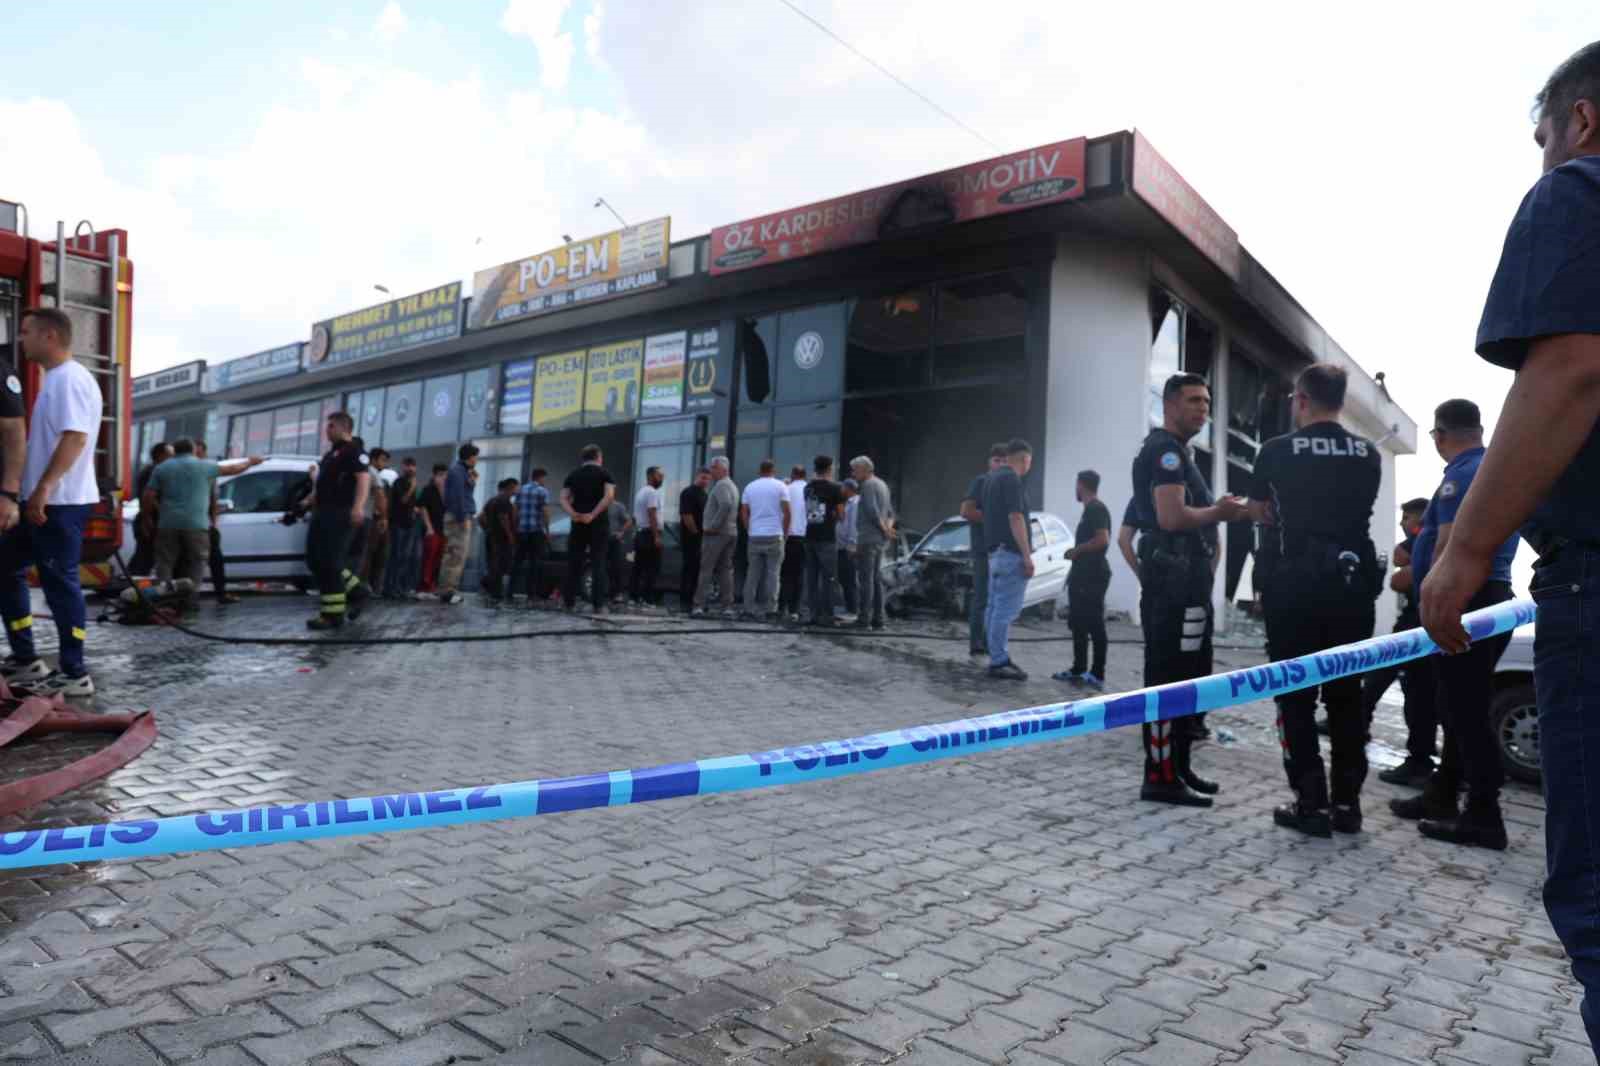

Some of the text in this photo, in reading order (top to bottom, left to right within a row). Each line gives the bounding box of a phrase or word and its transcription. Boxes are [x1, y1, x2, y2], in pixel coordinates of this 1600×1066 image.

[723, 223, 754, 250] ÖZ
[940, 150, 1061, 192] OMOTİV
[517, 239, 609, 293] PO-EM
[333, 284, 459, 334] MEHMET YILMAZ
[538, 357, 585, 376] PO-EM
